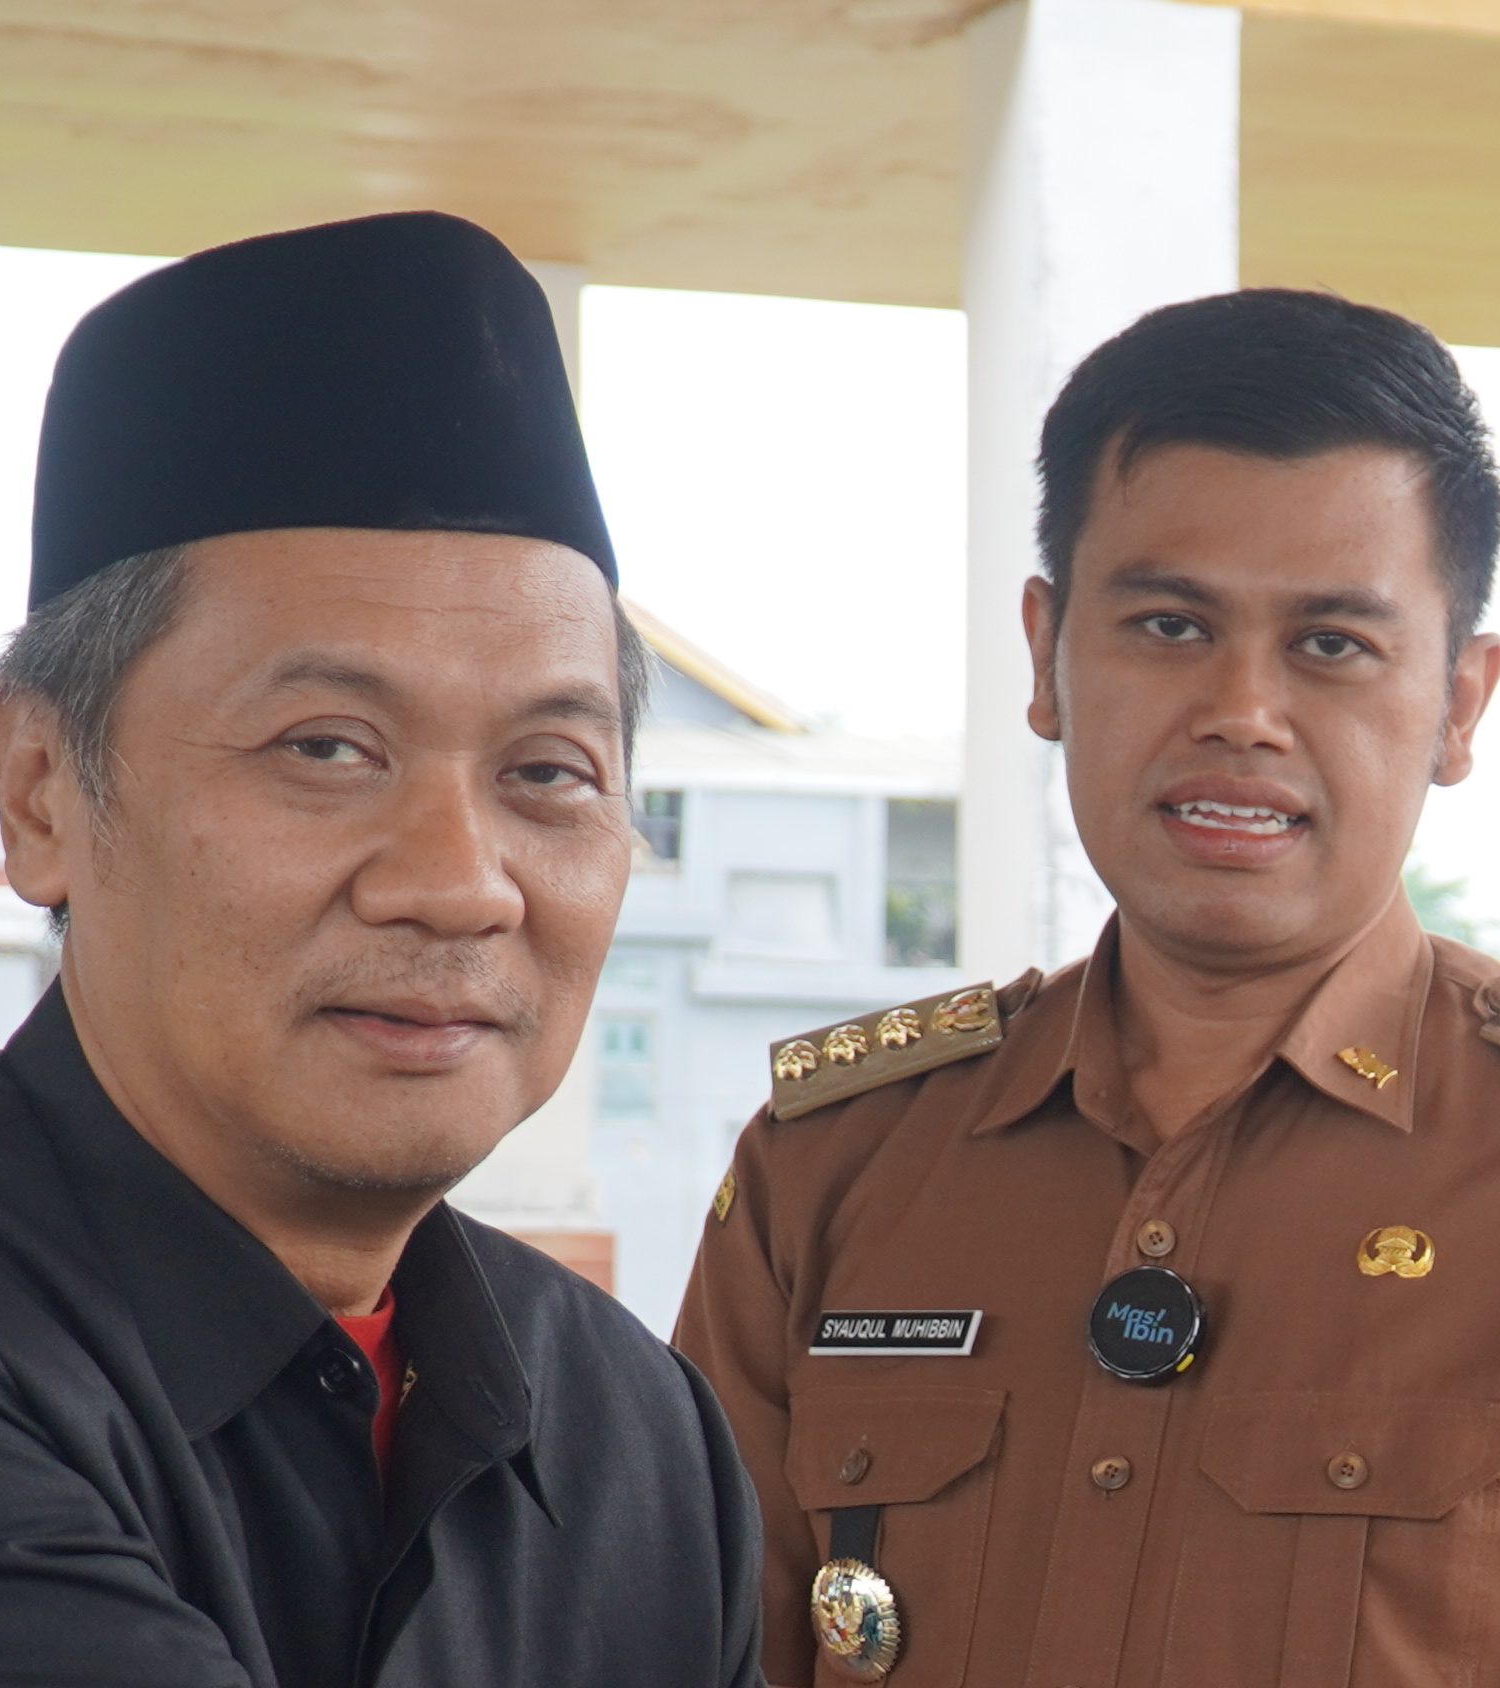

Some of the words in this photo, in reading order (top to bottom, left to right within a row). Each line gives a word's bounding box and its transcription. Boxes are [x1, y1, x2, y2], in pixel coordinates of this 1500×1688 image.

[1106, 1302, 1165, 1327] Mas!
[822, 1319, 885, 1338] SYAUQUL
[892, 1319, 964, 1338] MUHIBBIN
